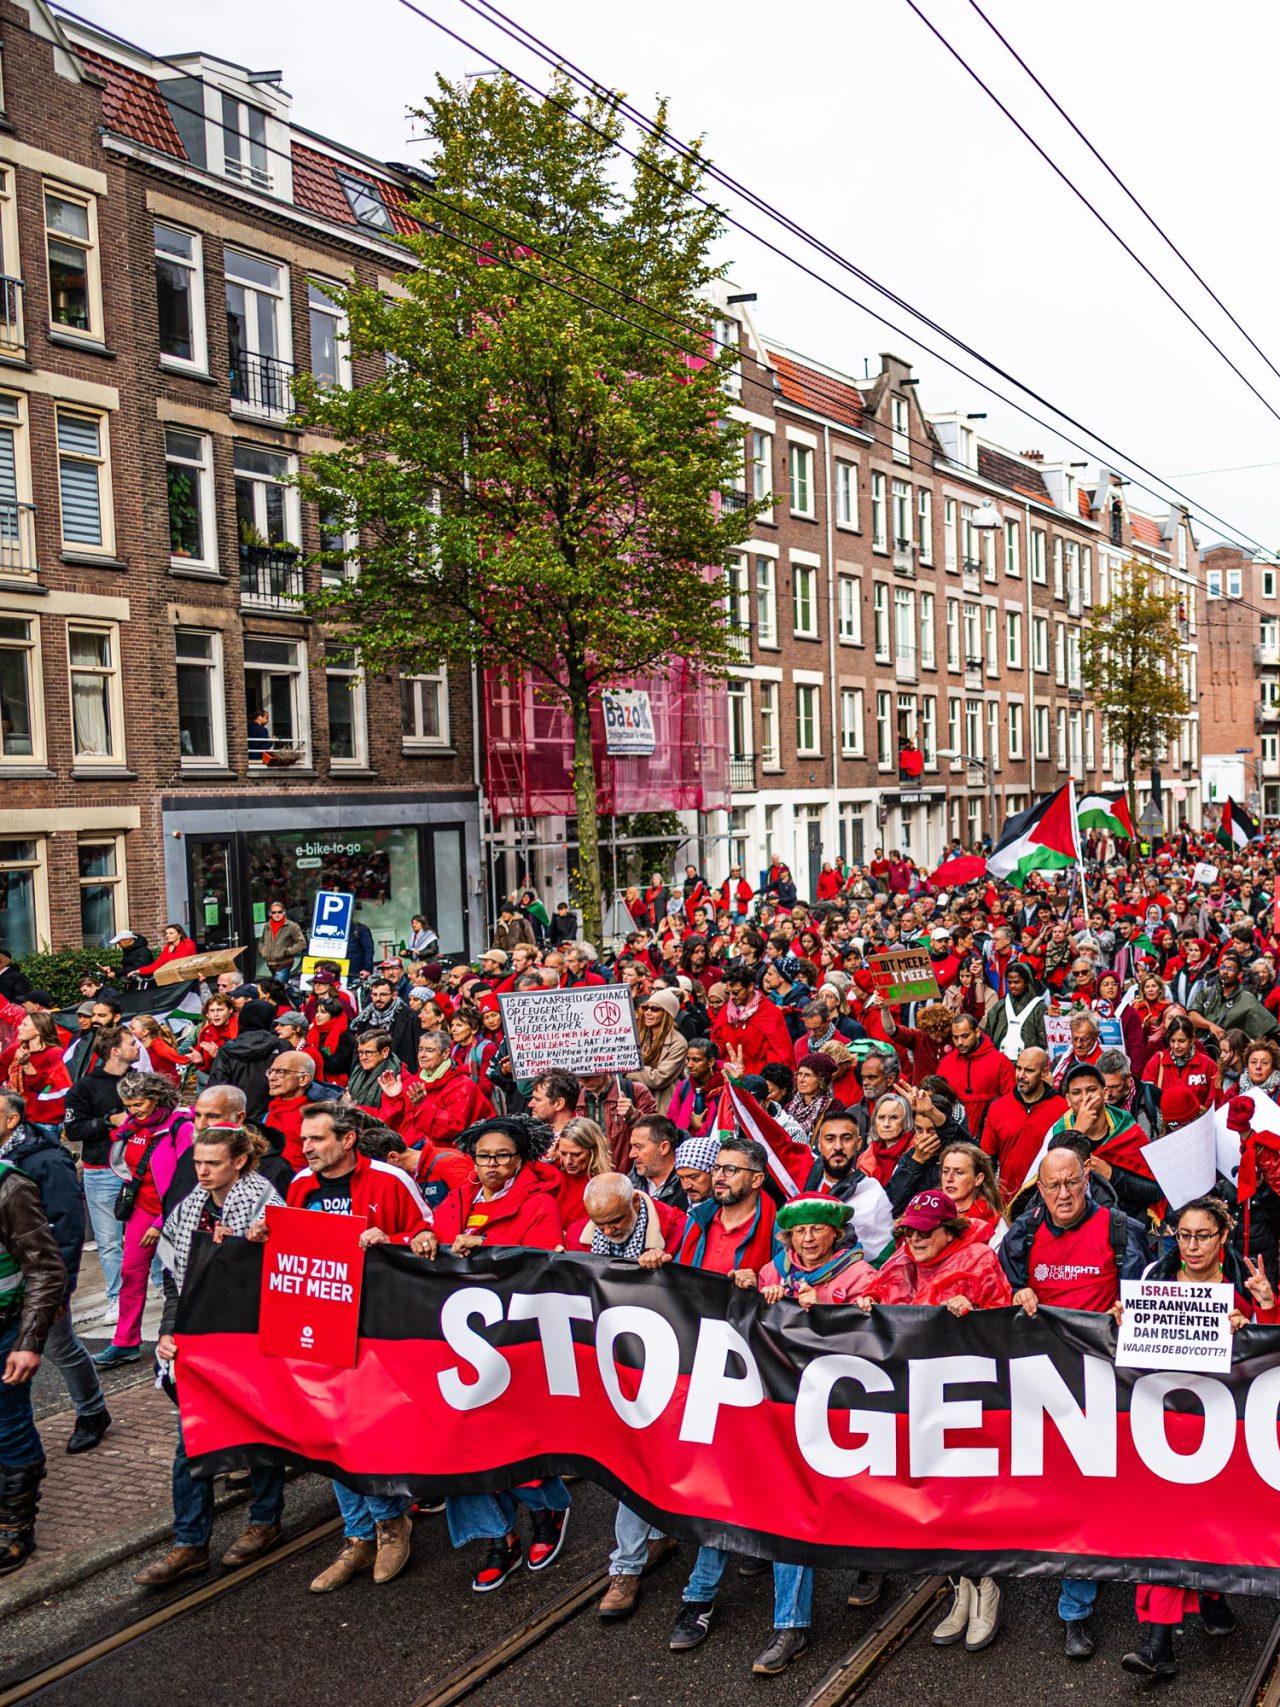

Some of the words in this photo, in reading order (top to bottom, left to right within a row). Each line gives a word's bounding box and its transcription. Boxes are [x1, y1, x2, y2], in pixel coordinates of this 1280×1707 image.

[296, 842, 361, 856] e-bike-to-go
[323, 896, 344, 920] P
[506, 999, 515, 1008] IS
[517, 998, 530, 1007] DE
[531, 993, 582, 1005] WAARHEID
[506, 1007, 520, 1016] OP
[522, 1004, 563, 1015] LEUGENS
[527, 1015, 547, 1023] ZEG
[1049, 1021, 1070, 1030] GAZ
[515, 1025, 530, 1034] BIJ
[531, 1024, 544, 1032] DE
[544, 1021, 582, 1032] KAPPER
[562, 1031, 578, 1039] HEB
[515, 1042, 531, 1051] ALS
[578, 1037, 601, 1047] LAAT
[614, 1035, 627, 1043] ME
[515, 1060, 525, 1068] EN
[526, 1059, 552, 1068] TRUMP
[552, 1057, 571, 1066] ZEGT
[571, 1056, 584, 1064] DAT
[593, 1054, 615, 1062] VREDE
[516, 1051, 544, 1060] ALTIJD
[516, 1068, 530, 1077] DAT
[277, 1253, 308, 1275] WIJ
[310, 1258, 348, 1282] ZIJN
[1049, 1272, 1078, 1280] FORUM
[269, 1272, 303, 1295] MET
[306, 1279, 353, 1303] MEER
[1141, 1285, 1188, 1298] ISRAEL:
[1190, 1287, 1212, 1299] 12X
[1125, 1299, 1158, 1311] MEER
[1159, 1300, 1229, 1314] AANVALLEN
[1134, 1312, 1151, 1324] OP
[1153, 1311, 1219, 1328] PATIËNTEN
[1133, 1327, 1159, 1339] DAN
[1161, 1329, 1219, 1342] RUSLAND
[1123, 1343, 1152, 1353] WAAR
[1152, 1344, 1161, 1353] IS
[1161, 1345, 1176, 1354] DE
[1175, 1346, 1227, 1357] BOYCOTT?!
[437, 1287, 764, 1444] STOP
